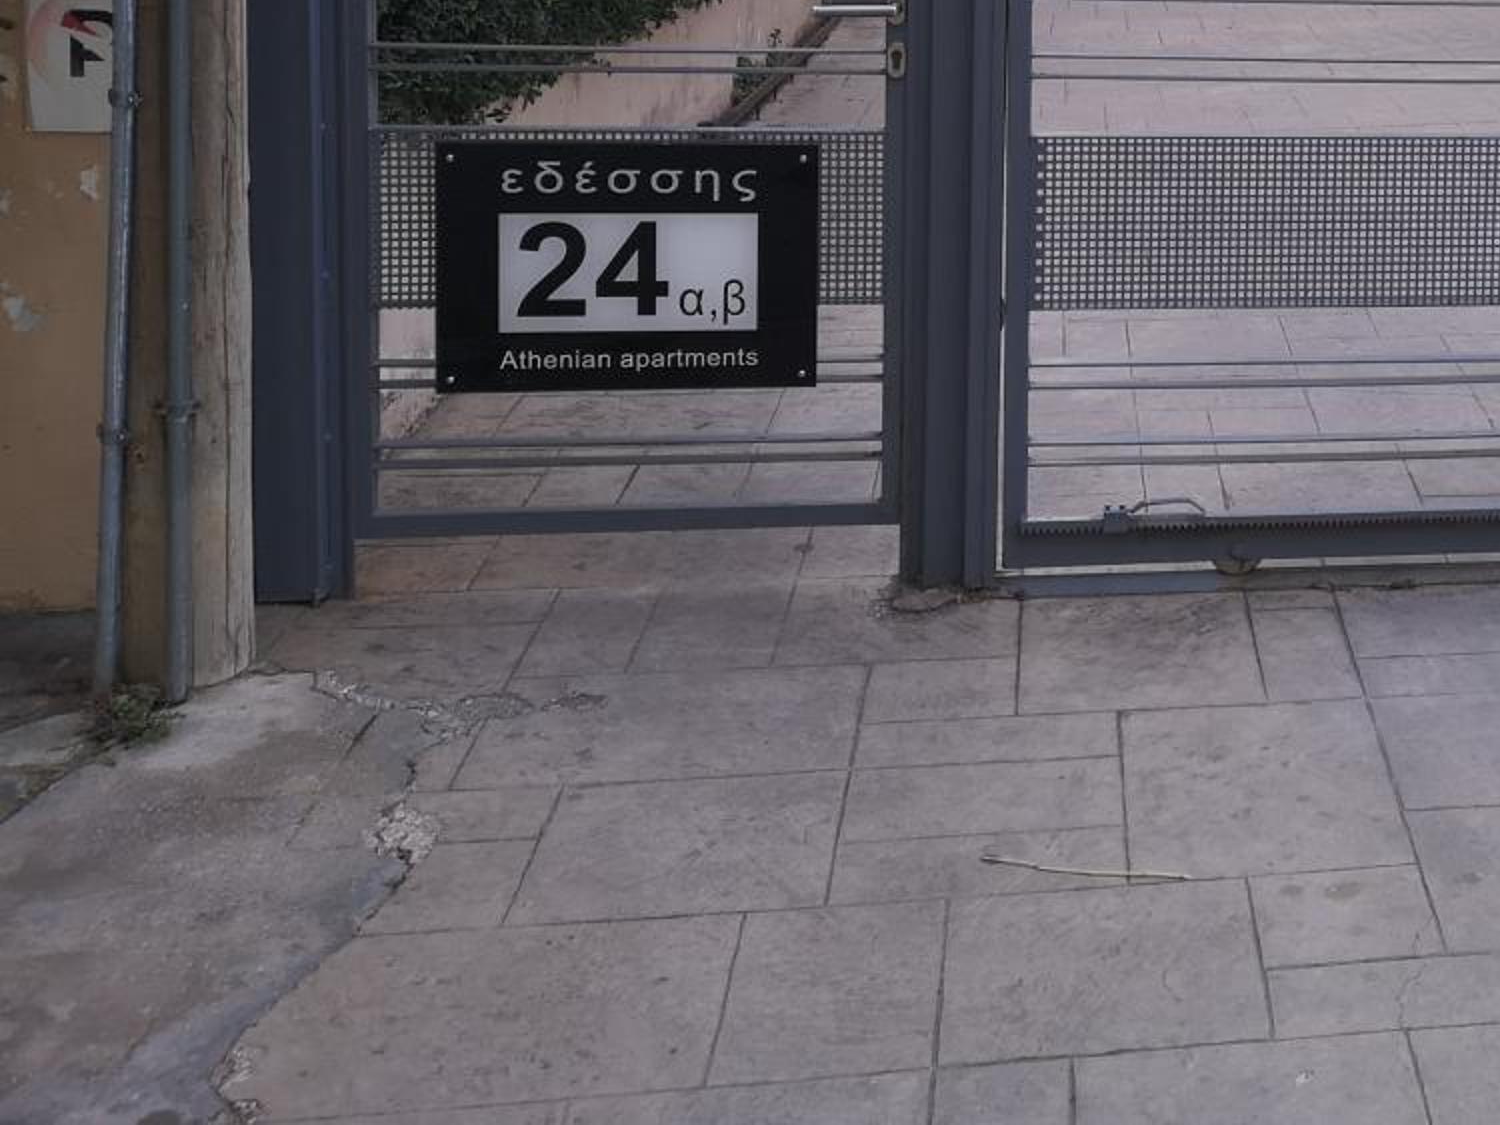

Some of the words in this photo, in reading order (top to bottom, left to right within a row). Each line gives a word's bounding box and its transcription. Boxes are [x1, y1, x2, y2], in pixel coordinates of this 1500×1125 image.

[501, 160, 758, 203] εδέσσης
[517, 221, 669, 317] 24
[501, 350, 612, 371] Athenian
[620, 348, 759, 373] apartments
